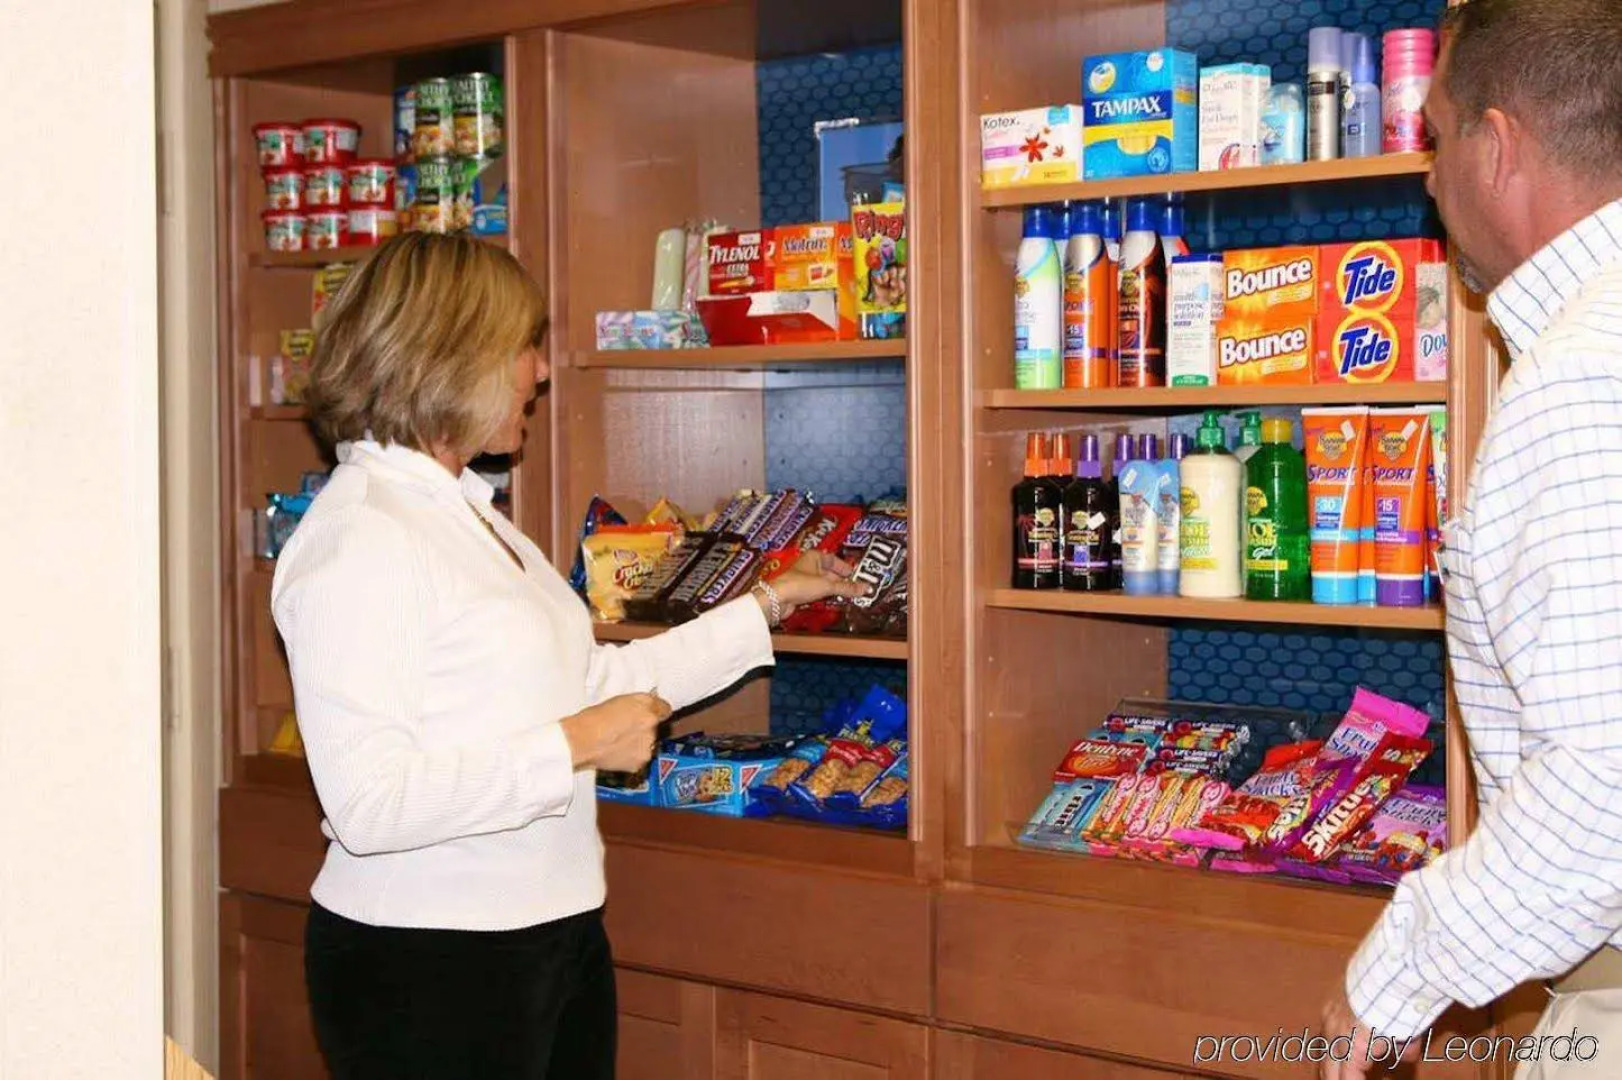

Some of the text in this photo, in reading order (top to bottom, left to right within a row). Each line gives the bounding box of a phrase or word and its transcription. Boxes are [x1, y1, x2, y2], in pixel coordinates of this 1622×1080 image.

[1091, 95, 1162, 118] TAMPAX
[983, 114, 1016, 130] Kotex
[709, 245, 760, 265] TYLENOL
[1227, 258, 1312, 300] Bounce
[1342, 255, 1397, 306] Tide
[1219, 328, 1307, 367] Bounce
[1337, 327, 1391, 376] Tide
[1308, 464, 1356, 481] SPORT
[1371, 465, 1415, 481] SPORT
[1319, 499, 1335, 511] 30
[1381, 499, 1393, 511] 15
[1073, 742, 1139, 760] Dentyne
